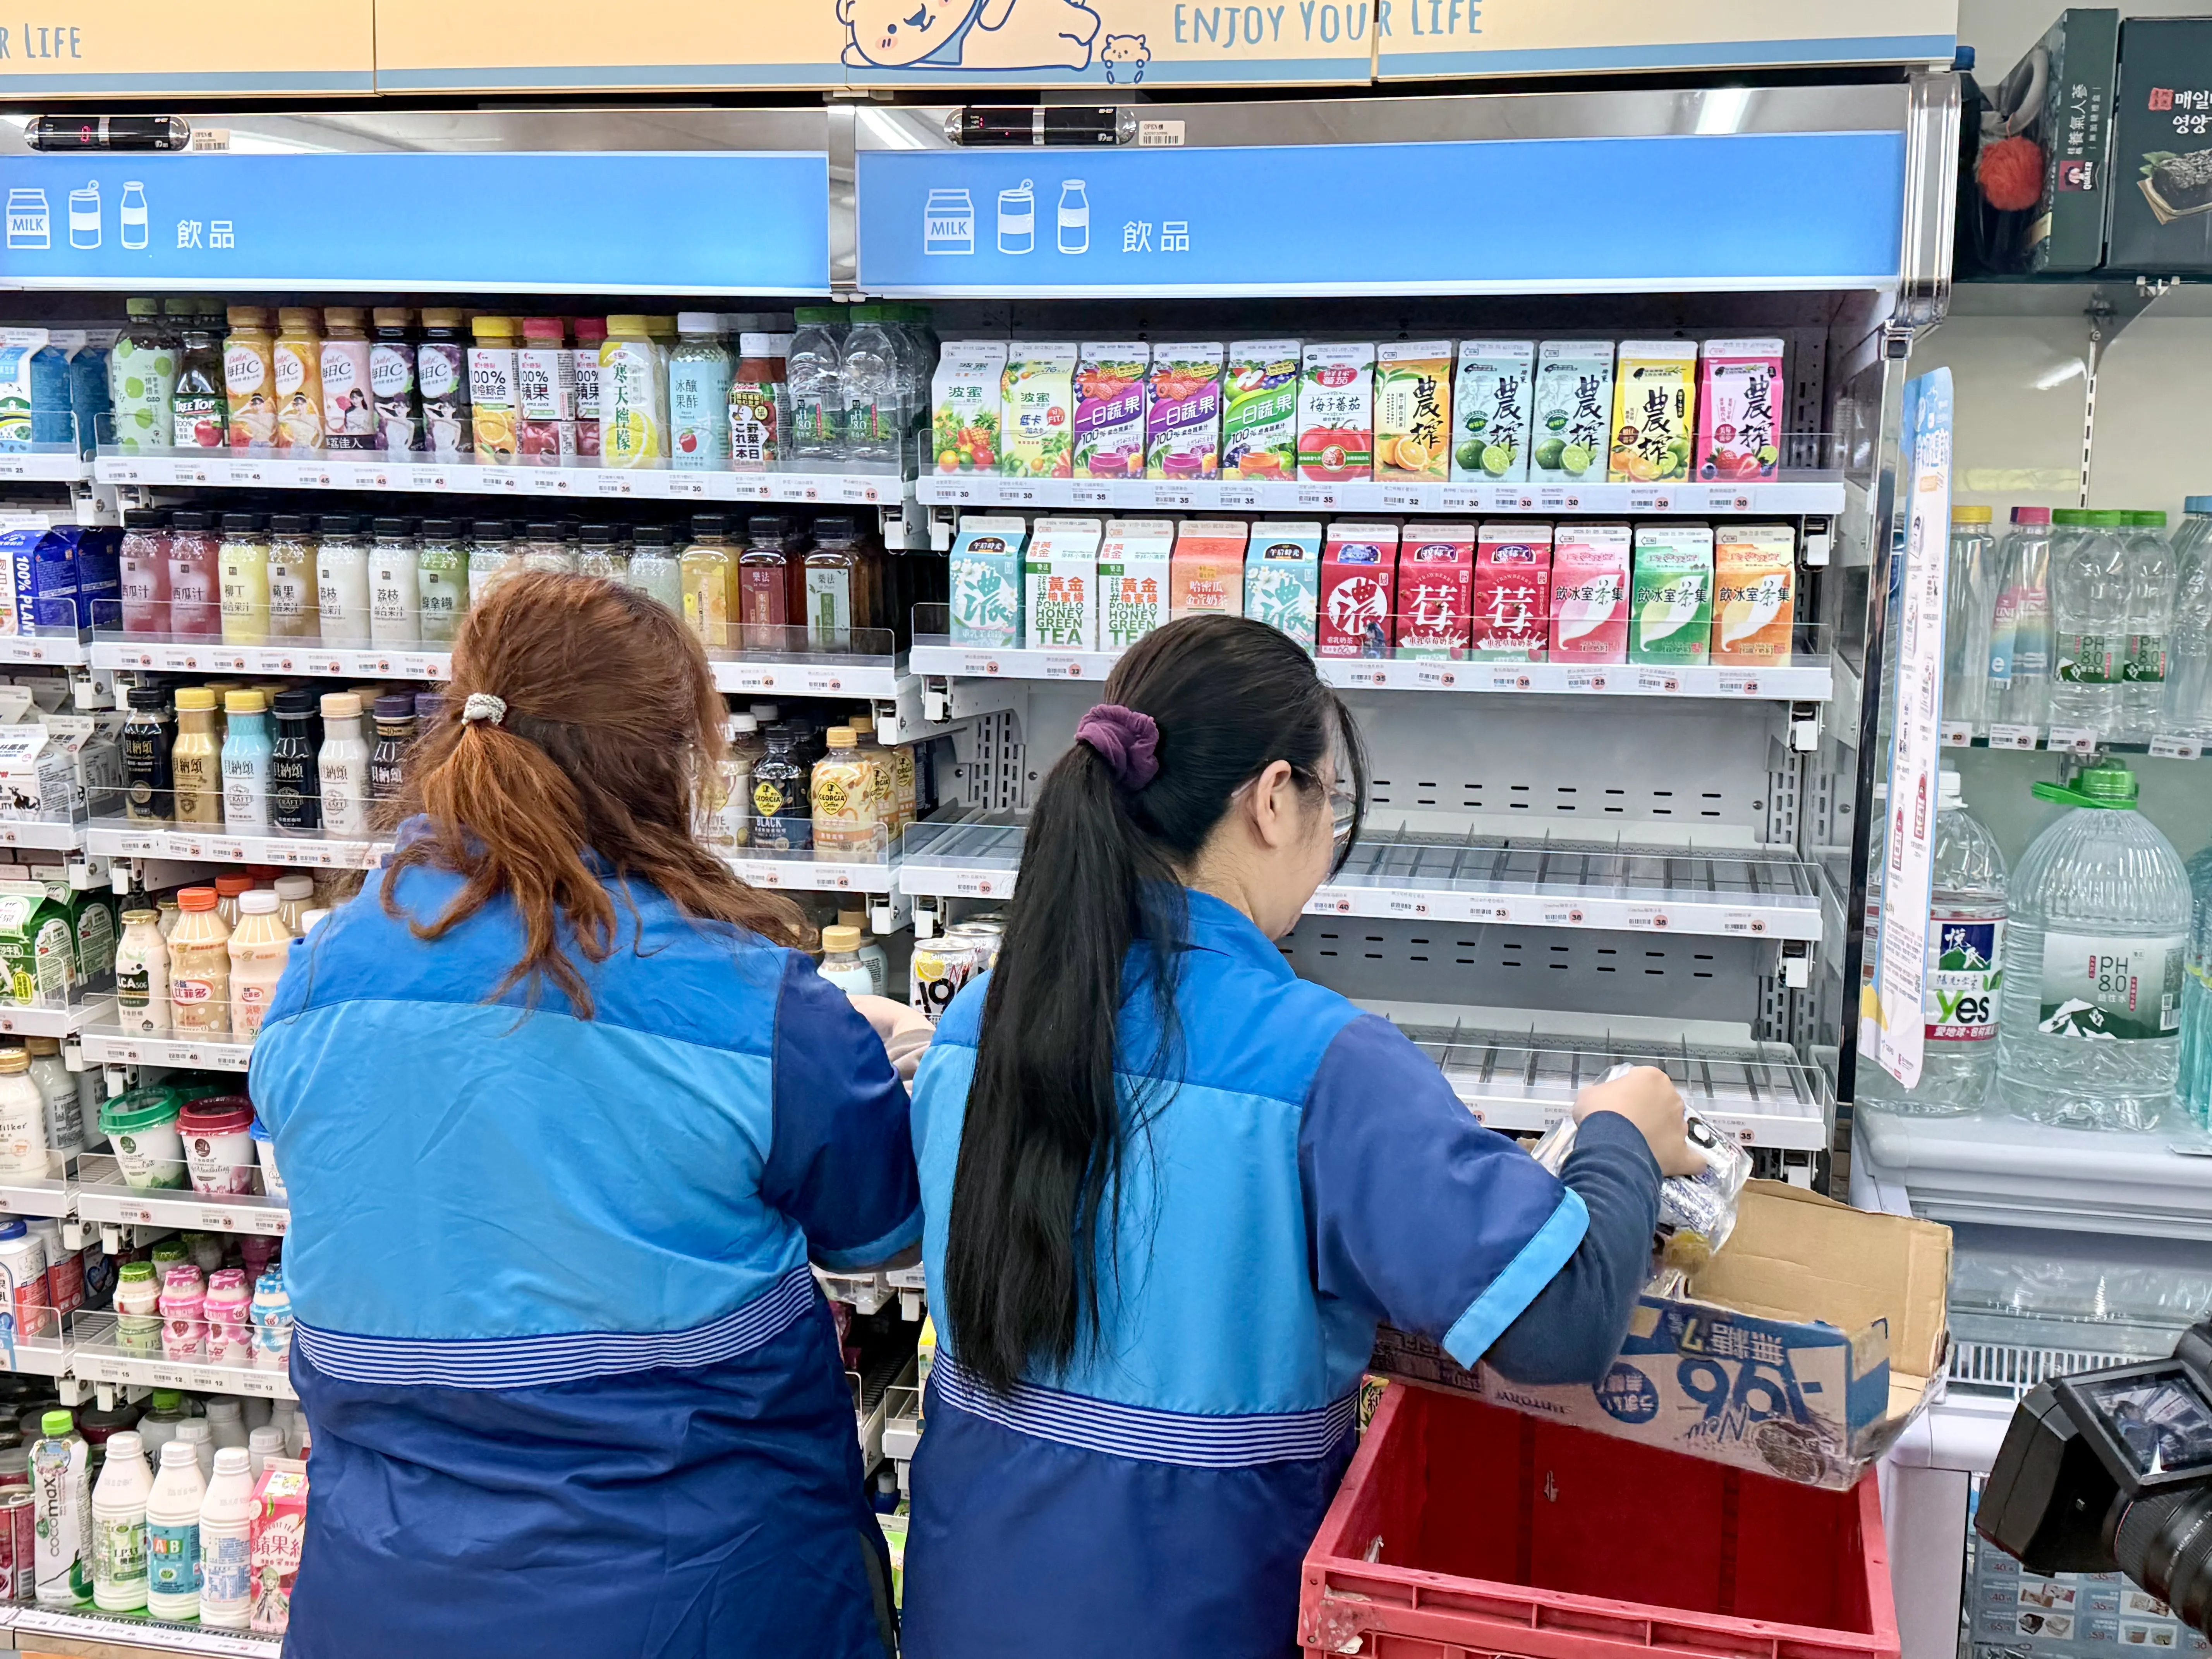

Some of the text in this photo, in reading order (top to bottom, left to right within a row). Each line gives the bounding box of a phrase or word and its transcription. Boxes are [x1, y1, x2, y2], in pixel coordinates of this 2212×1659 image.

[1174, 0, 1483, 45] ENJOY YOUR LIFE
[25, 23, 82, 59] LIFE
[2083, 161, 2093, 190] QUAKER
[12, 218, 44, 232] MILK
[930, 220, 967, 237] MILK
[176, 219, 235, 250] 飲品
[1122, 220, 1191, 254] 飲品
[227, 360, 259, 376] 每日C
[372, 362, 402, 380] 每日C
[471, 371, 506, 384] 100%
[520, 371, 548, 382] 100%
[522, 383, 549, 400] 蘋果
[675, 379, 697, 393] 冰釀
[949, 386, 982, 397] 波蜜
[175, 398, 215, 412] TREE TOP
[676, 395, 698, 409] 果酢
[1020, 392, 1050, 402] 波蜜
[613, 363, 630, 450] 寒天檸檬
[1077, 395, 1140, 426] 一日蔬果
[1151, 395, 1215, 426] 一日蔬果
[1226, 394, 1292, 424] 一日蔬果
[796, 410, 807, 424] pH
[850, 410, 862, 424] pH
[1020, 414, 1041, 426] 低卡
[735, 423, 747, 459] これ一本
[747, 423, 759, 459] 野菜一日
[1082, 428, 1106, 446] 100%
[1156, 428, 1180, 447] 100%
[1231, 428, 1256, 446] 100%
[1037, 541, 1052, 558] 黃金
[753, 571, 770, 582] 樂法
[818, 574, 835, 584] 樂法
[1048, 576, 1084, 592] 黃金
[122, 584, 150, 598] 西瓜汁
[225, 584, 245, 597] 柳丁
[273, 585, 295, 598] 蘋果
[1121, 577, 1158, 593] 黃金
[1555, 580, 1624, 606] 飲冰室茶集
[1638, 580, 1707, 606] 飲冰室茶集
[16, 556, 36, 637] 100% PLANT
[173, 587, 204, 601] 西瓜汁
[320, 587, 337, 600] 荔枝
[377, 589, 399, 602] 荔枝
[1719, 581, 1790, 607] 飲冰室茶集
[1036, 601, 1084, 610] POMELO
[1036, 609, 1083, 618] HONEY
[1109, 603, 1158, 611] POMELO
[1408, 584, 1458, 632] 莓
[1486, 586, 1536, 634] 莓
[1036, 618, 1083, 628] GREEN
[1109, 611, 1157, 620] HONEY
[1109, 620, 1156, 630] GREEN
[1036, 627, 1083, 645] TEA
[1109, 630, 1139, 646] TE
[2083, 636, 2105, 649] PH
[2140, 636, 2160, 649] PH
[126, 740, 152, 754] 貝納頌
[173, 758, 203, 774] 貝納頌
[225, 760, 254, 775] 貝納頌
[273, 761, 303, 778] 貝納頌
[320, 764, 347, 780] 貝納頌
[756, 816, 782, 828] BLACK
[2100, 956, 2128, 974] PH
[2098, 974, 2126, 993] 8.0
[174, 988, 207, 998] 比菲多
[1496, 1391, 1569, 1415] SUNTORY
[1684, 1407, 1750, 1444] New
[43, 1476, 60, 1558] cocomax
[264, 1522, 283, 1532] FRUIT
[114, 1547, 139, 1557] LP33
[155, 1539, 182, 1554] AB
